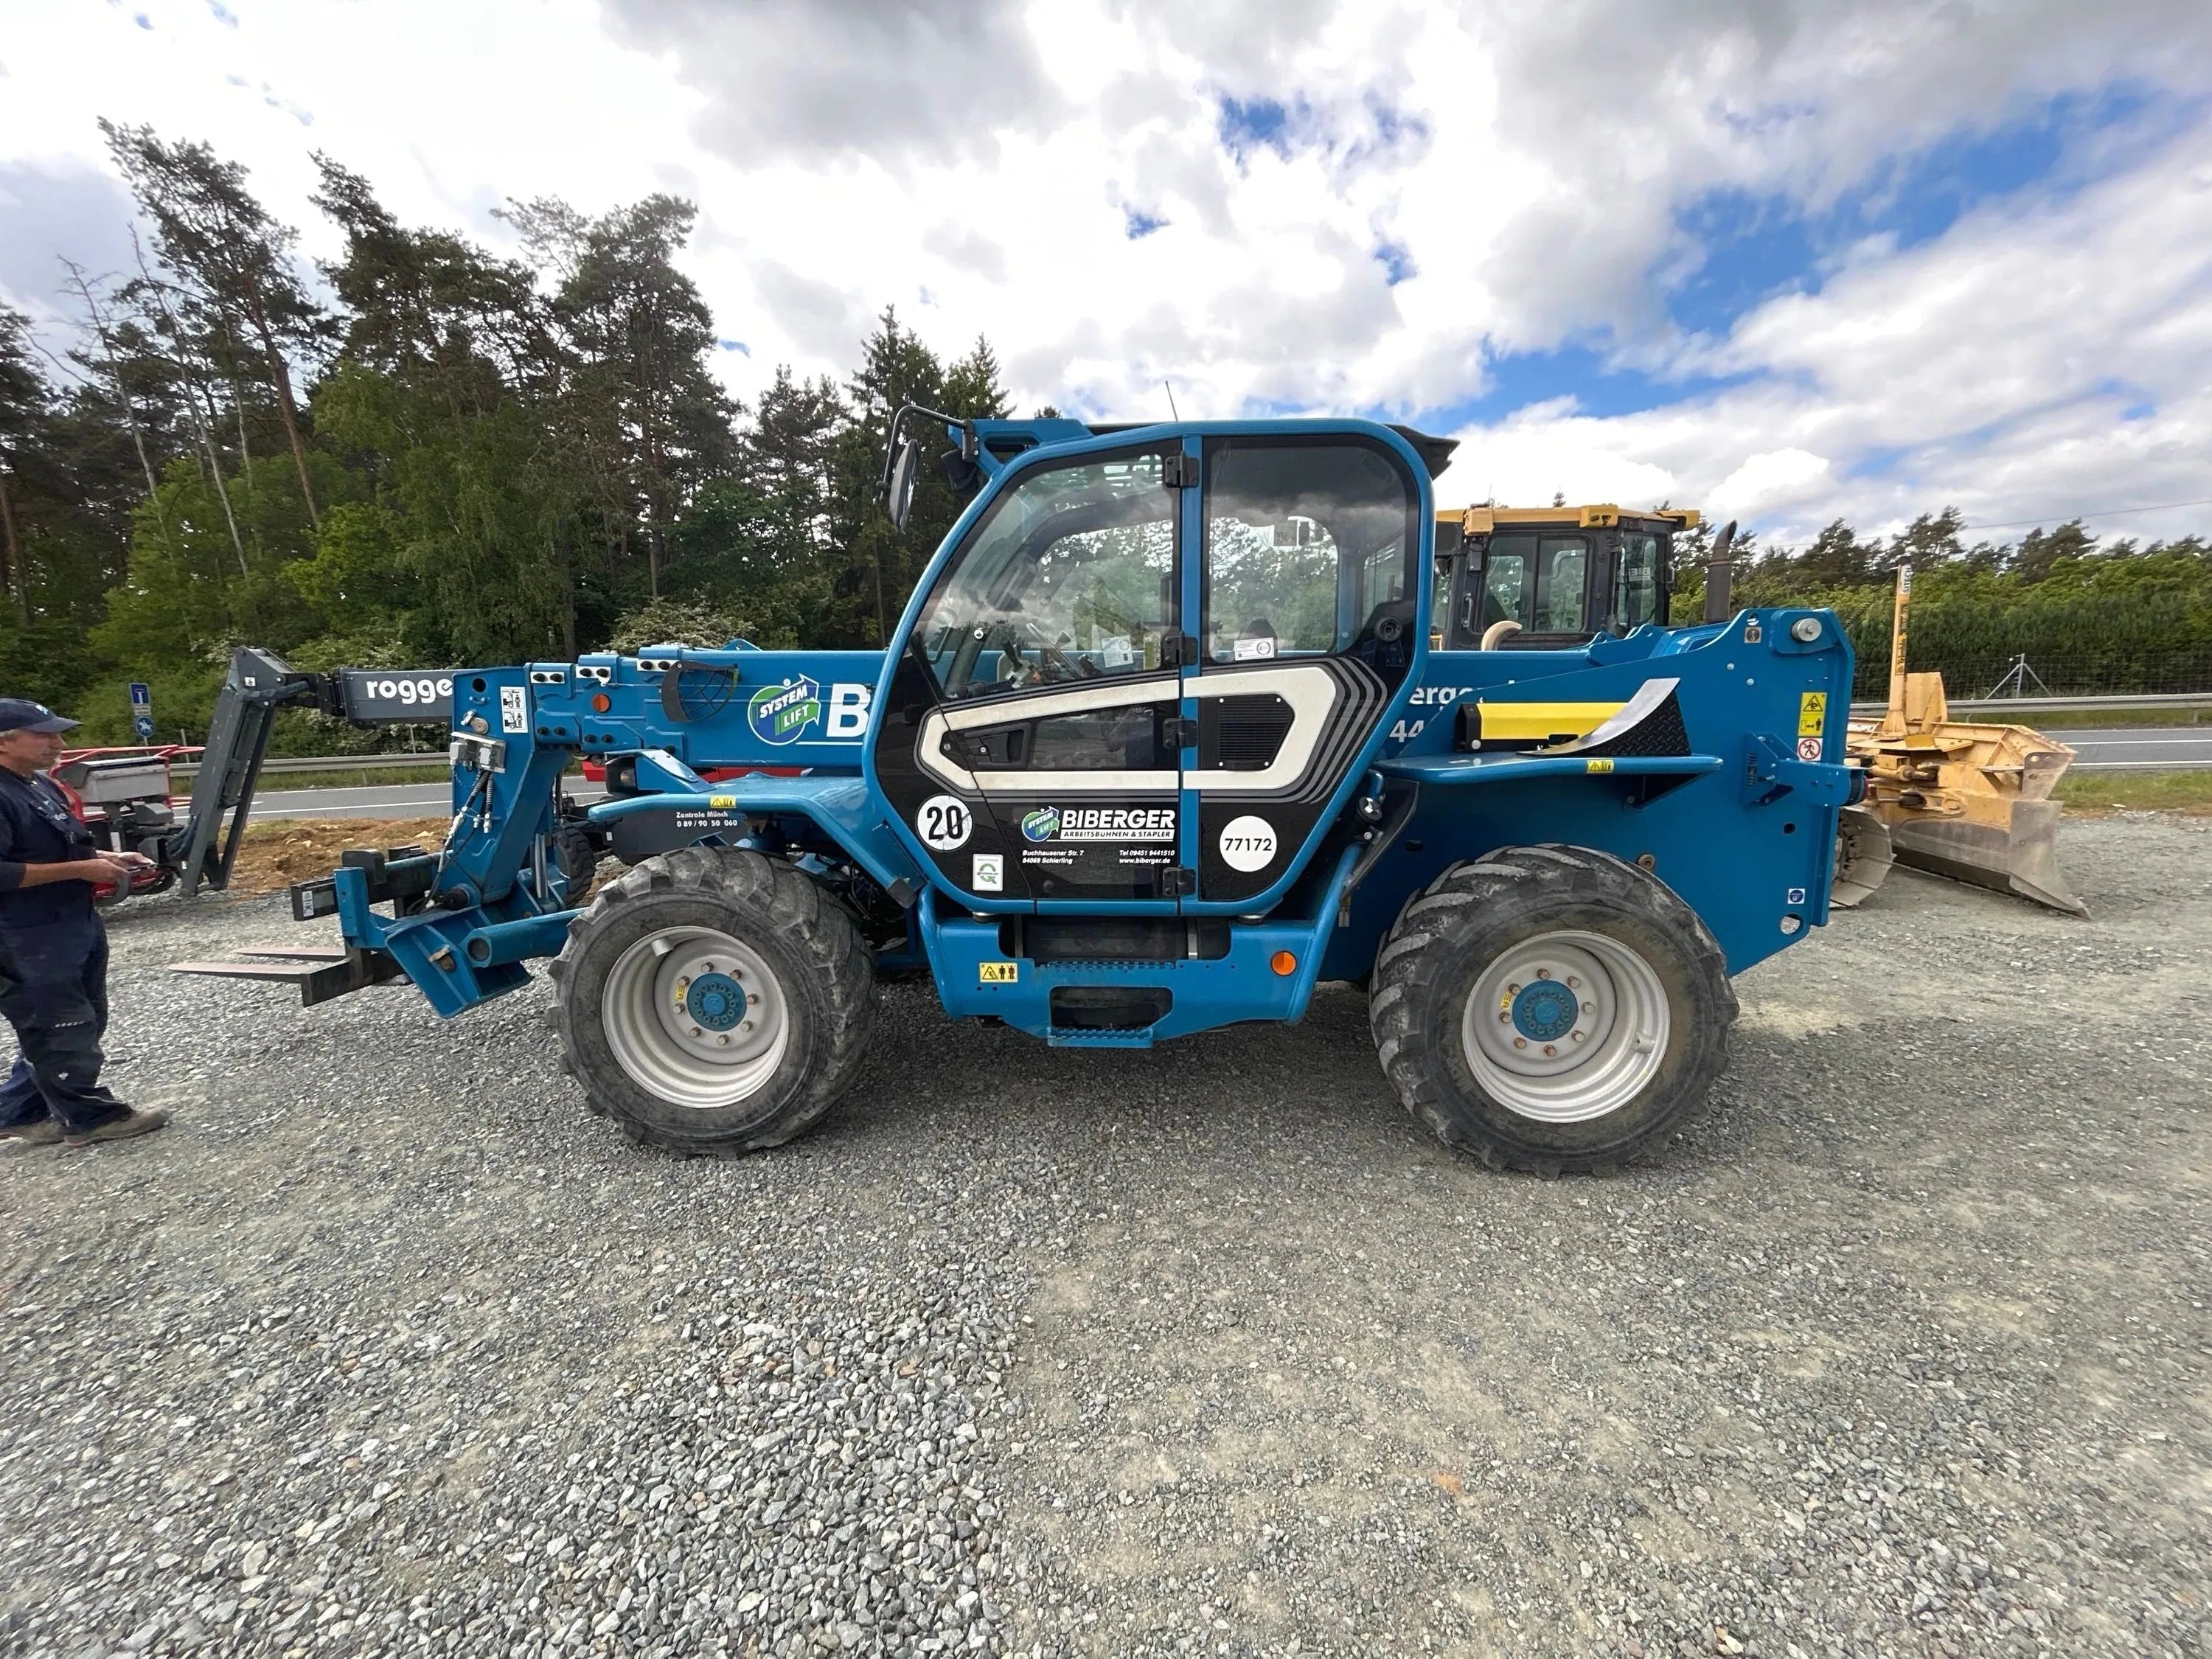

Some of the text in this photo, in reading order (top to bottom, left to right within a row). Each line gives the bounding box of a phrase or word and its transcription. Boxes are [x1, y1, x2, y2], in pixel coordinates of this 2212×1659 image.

[366, 678, 453, 704] rogge
[759, 684, 808, 719] SYSTEM
[784, 703, 810, 728] LIFT
[827, 684, 871, 737] B
[927, 805, 963, 840] 20
[1028, 810, 1054, 829] SYSTEM
[1040, 821, 1054, 833] LIFT
[1062, 809, 1175, 829] BIBERGER
[1225, 838, 1272, 851] 77172
[1042, 857, 1073, 865] Schierling
